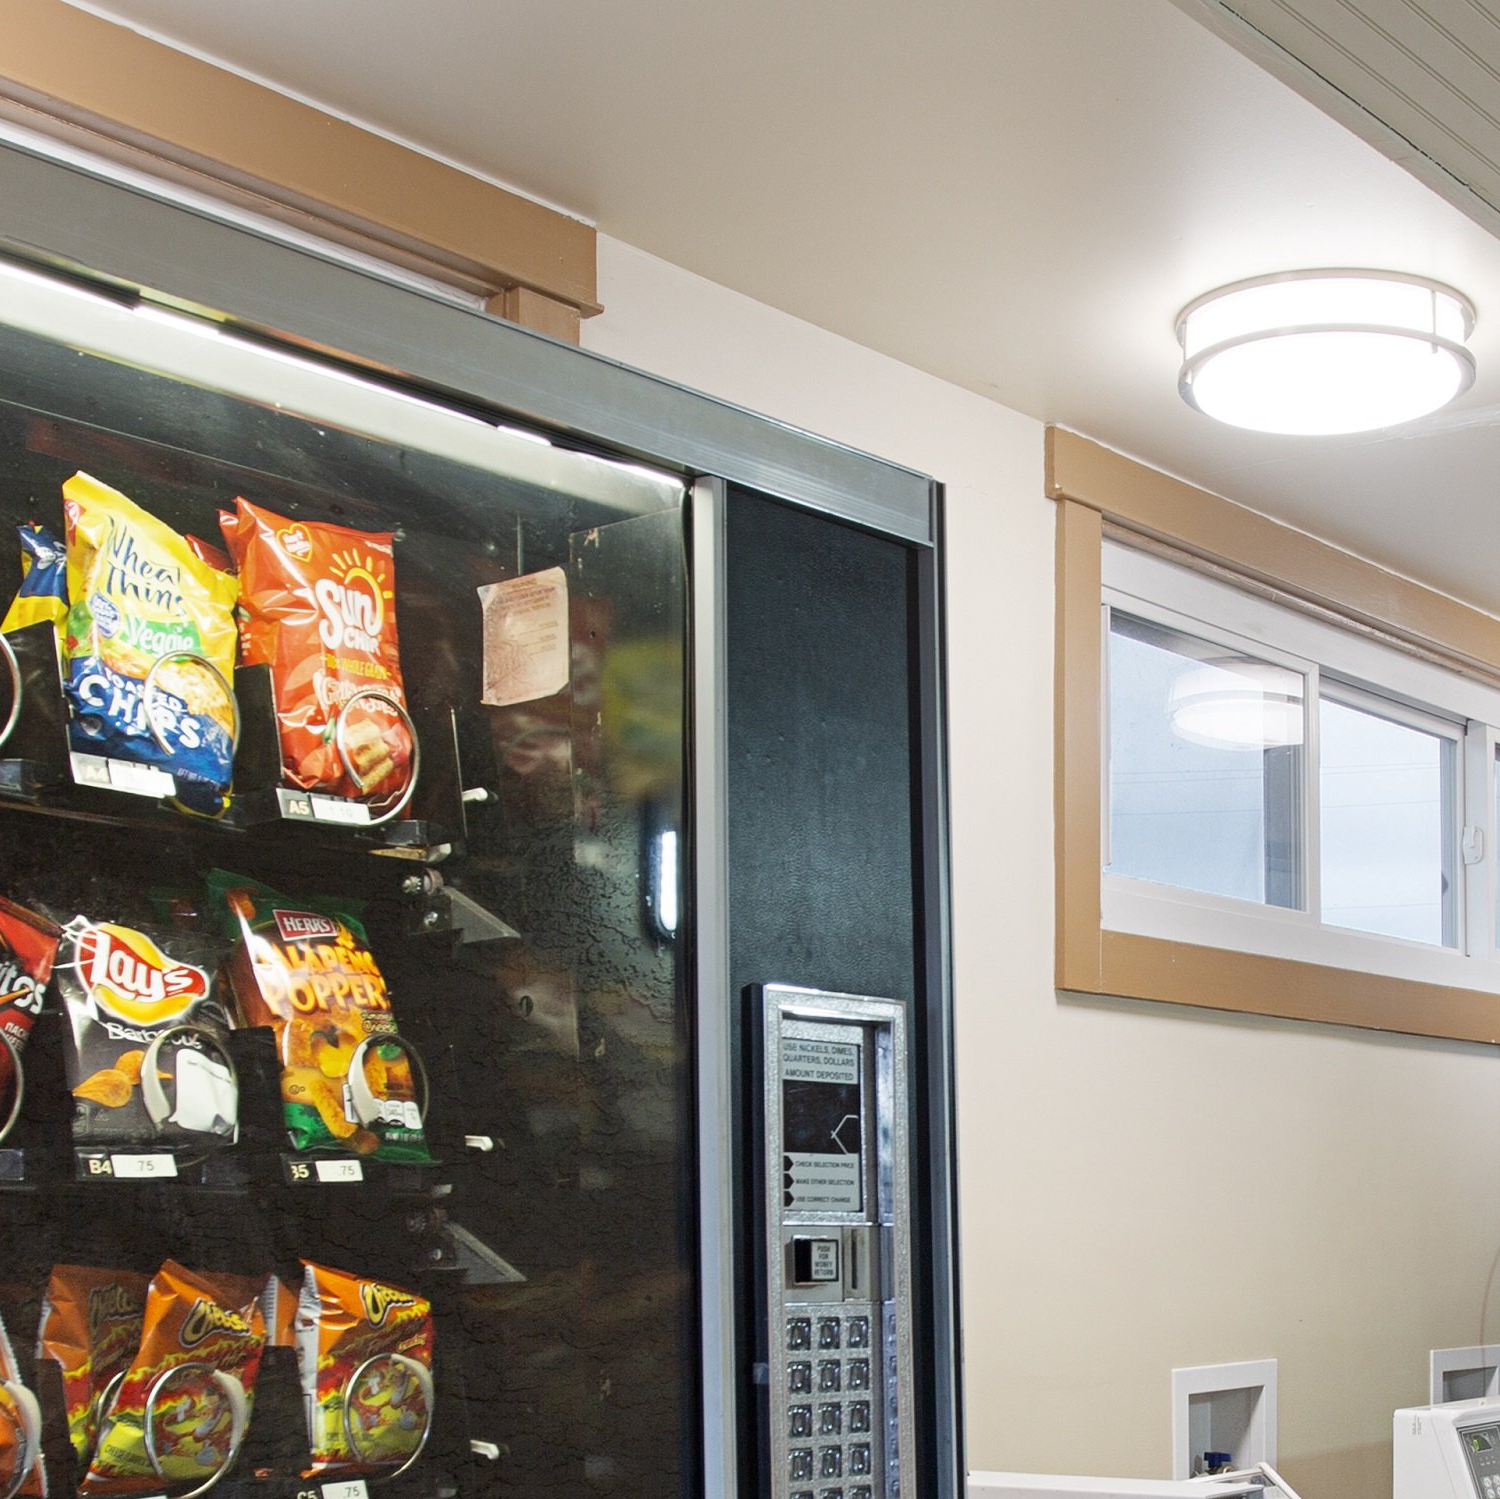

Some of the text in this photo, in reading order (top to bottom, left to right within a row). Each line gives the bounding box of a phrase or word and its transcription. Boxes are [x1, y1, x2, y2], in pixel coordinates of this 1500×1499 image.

[124, 615, 194, 658] Veggie
[78, 674, 201, 749] CHIPS
[289, 800, 311, 816] A5
[89, 930, 195, 1004] Lay's
[823, 1056, 855, 1068] DOLLARS
[785, 1068, 854, 1081] AMOUNT DEPOSITED
[89, 1159, 113, 1175] B4
[795, 1160, 812, 1168] CHECK
[813, 1161, 840, 1169] SELECTION
[811, 1178, 827, 1186] OTHER
